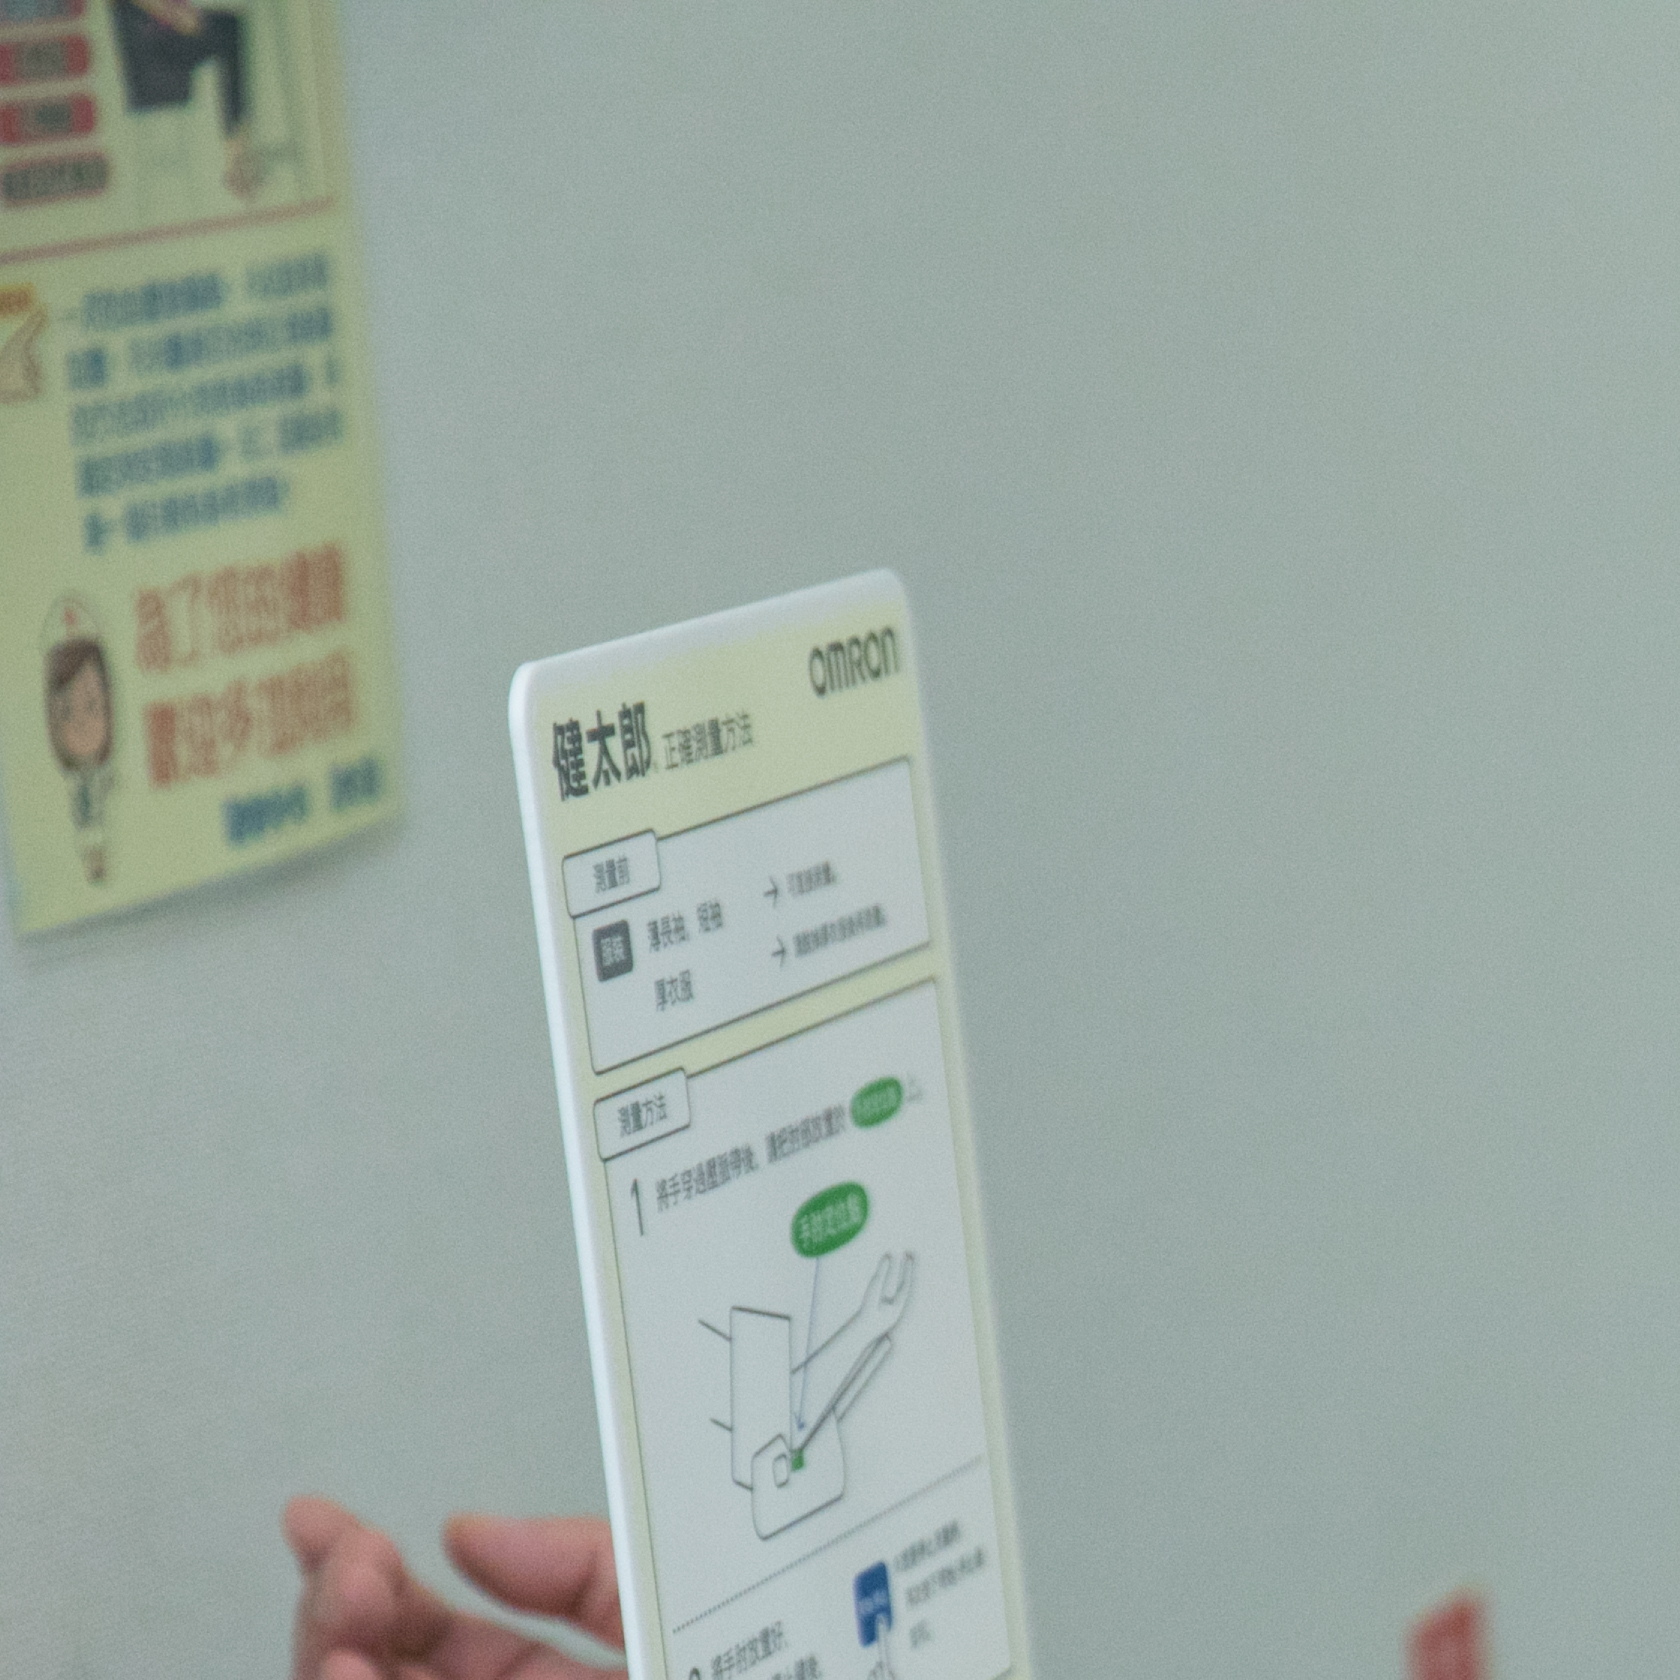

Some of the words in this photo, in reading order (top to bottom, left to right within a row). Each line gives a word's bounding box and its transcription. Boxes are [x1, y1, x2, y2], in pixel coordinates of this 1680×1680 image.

[809, 626, 900, 698] OMRON
[551, 701, 653, 801] 健太郎
[661, 709, 755, 772] 正確測量方法
[617, 1094, 668, 1137] 測量方法
